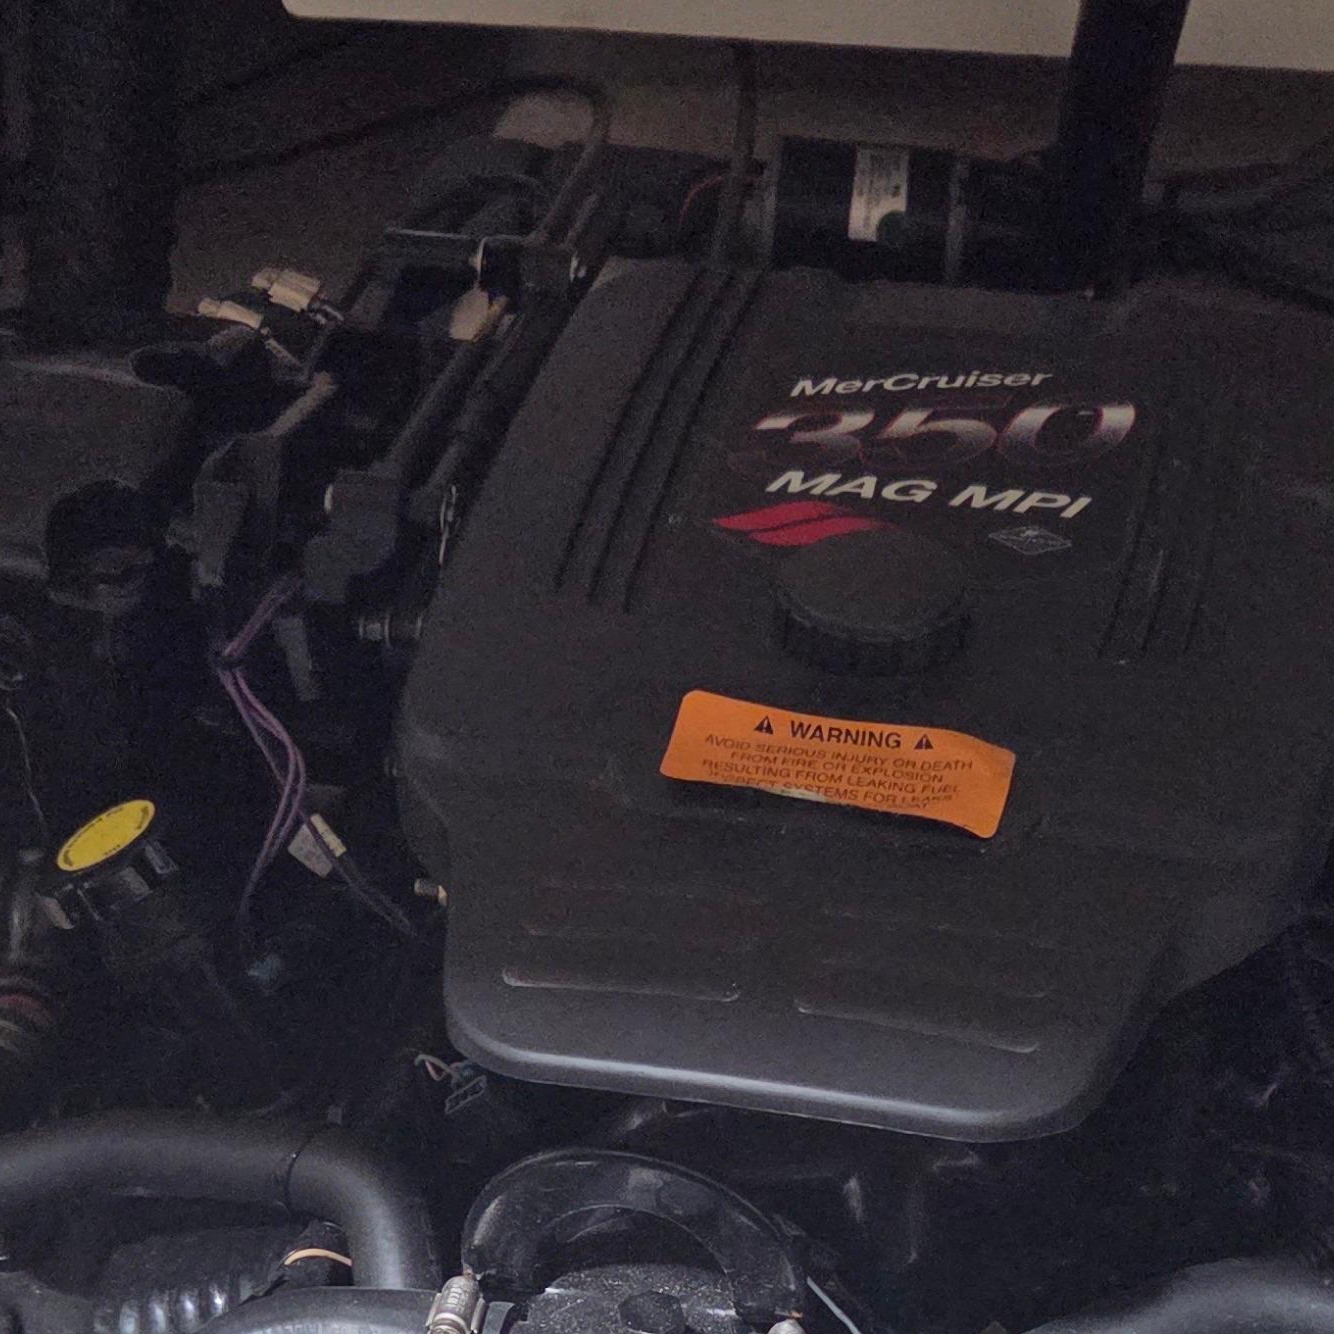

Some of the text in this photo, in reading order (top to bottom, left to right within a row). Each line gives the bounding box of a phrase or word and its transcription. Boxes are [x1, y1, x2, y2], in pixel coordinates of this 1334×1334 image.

[790, 370, 1054, 397] MerCruiser
[765, 470, 1093, 518] MAG MPI
[790, 720, 901, 749] WARNING
[705, 734, 973, 772] AVOID SERIOUS INJURY OR DEATH
[730, 751, 943, 783] FROM FIRE OR EXPLOSION
[702, 759, 961, 794] RESULTING FROM LEAKING FUEL
